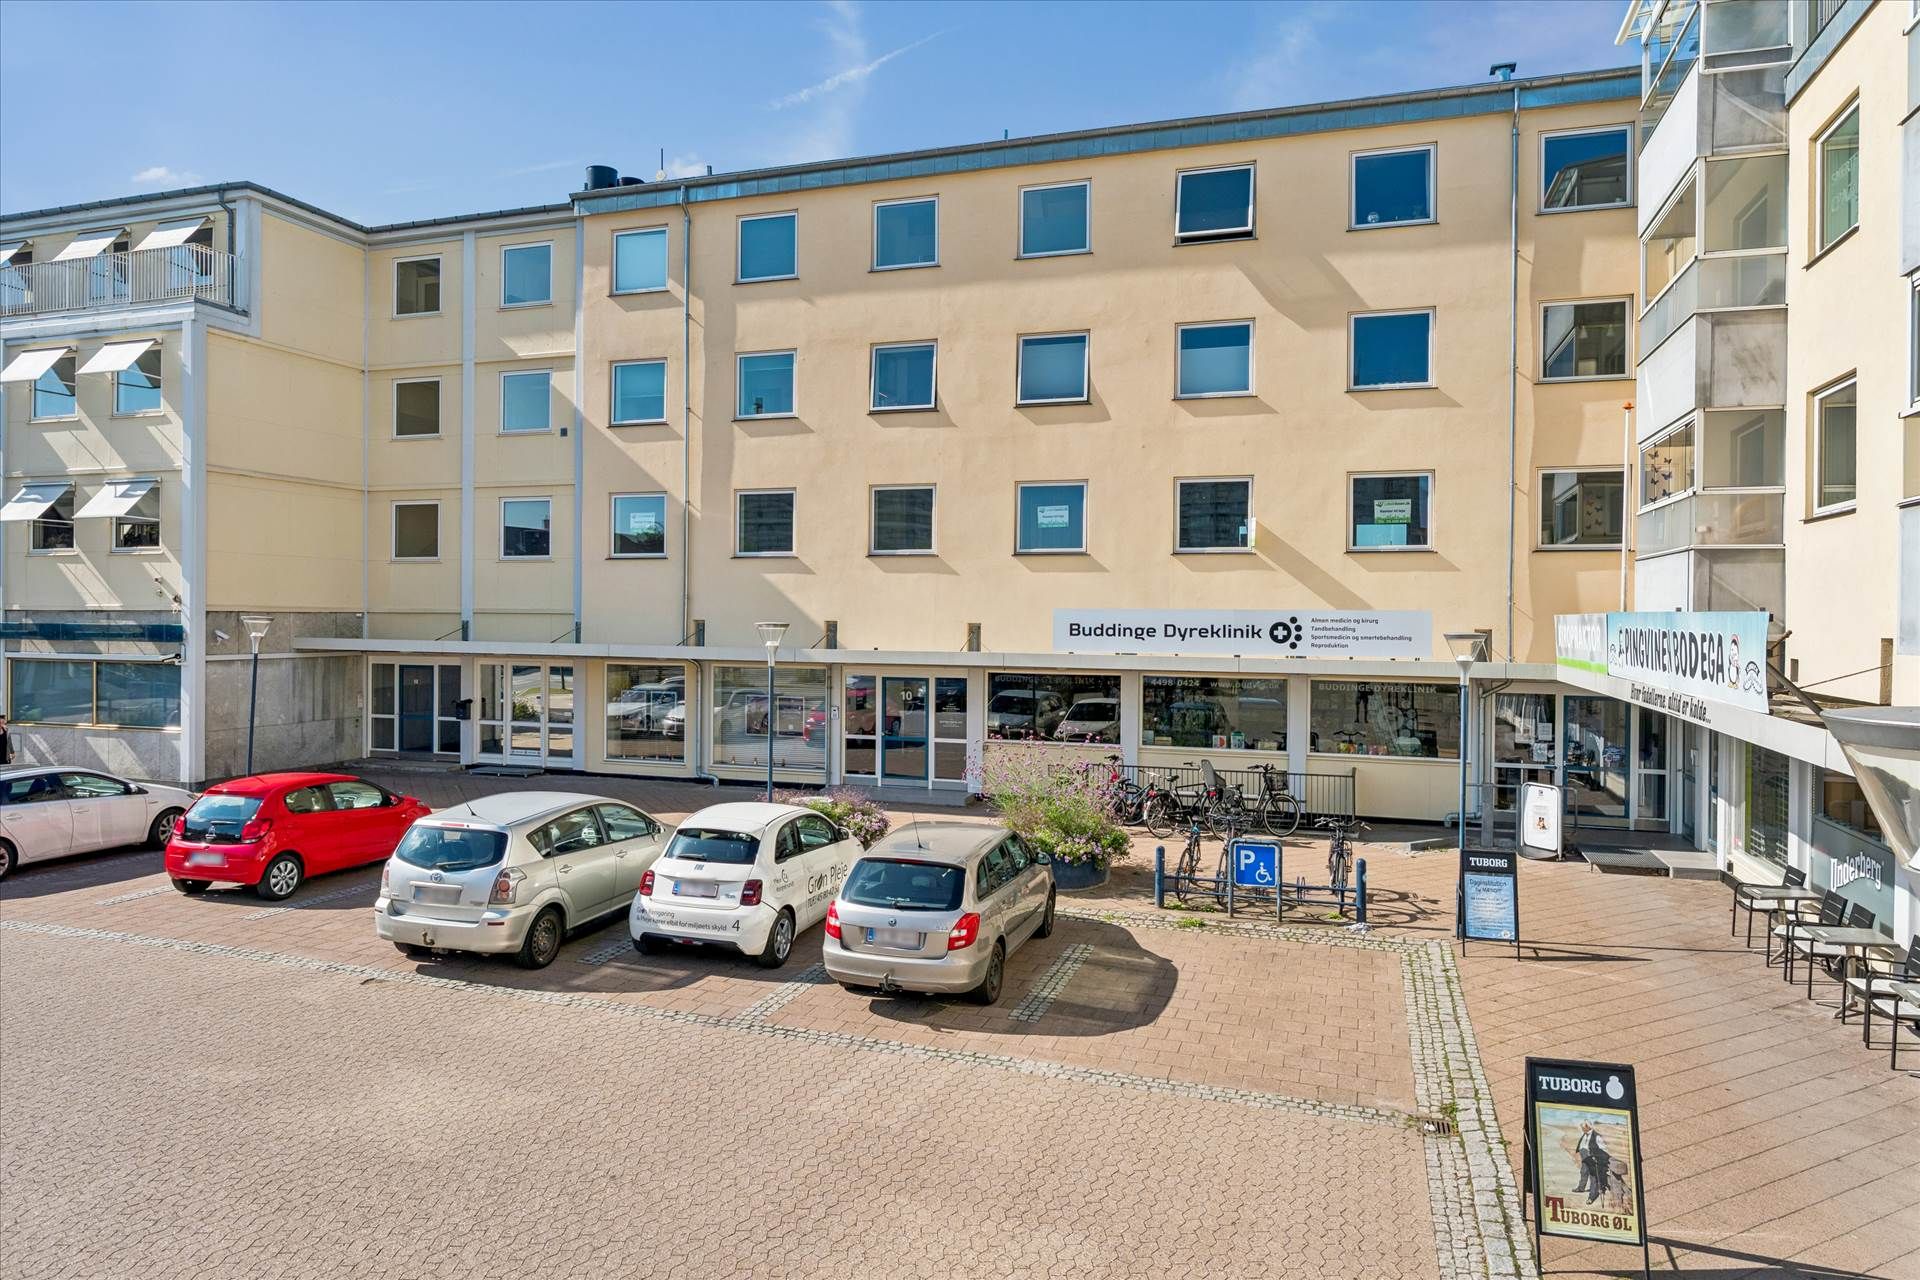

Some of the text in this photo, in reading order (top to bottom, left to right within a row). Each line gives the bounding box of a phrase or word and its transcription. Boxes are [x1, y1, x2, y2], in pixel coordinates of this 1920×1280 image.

[1069, 623, 1262, 642] Buddinge Dyreklinik
[1673, 631, 1725, 684] BODEGA
[1177, 679, 1200, 687] 0424
[1319, 683, 1437, 694] BUDDINGE DYREKLINIK
[901, 691, 912, 700] 10
[1240, 850, 1255, 870] P
[1469, 857, 1508, 868] TUBORG
[1830, 851, 1882, 893] Underberg
[711, 923, 727, 932] skyld
[731, 920, 740, 931] 4
[1539, 1075, 1602, 1095] TUBORG
[1613, 1217, 1632, 1231] ØL
